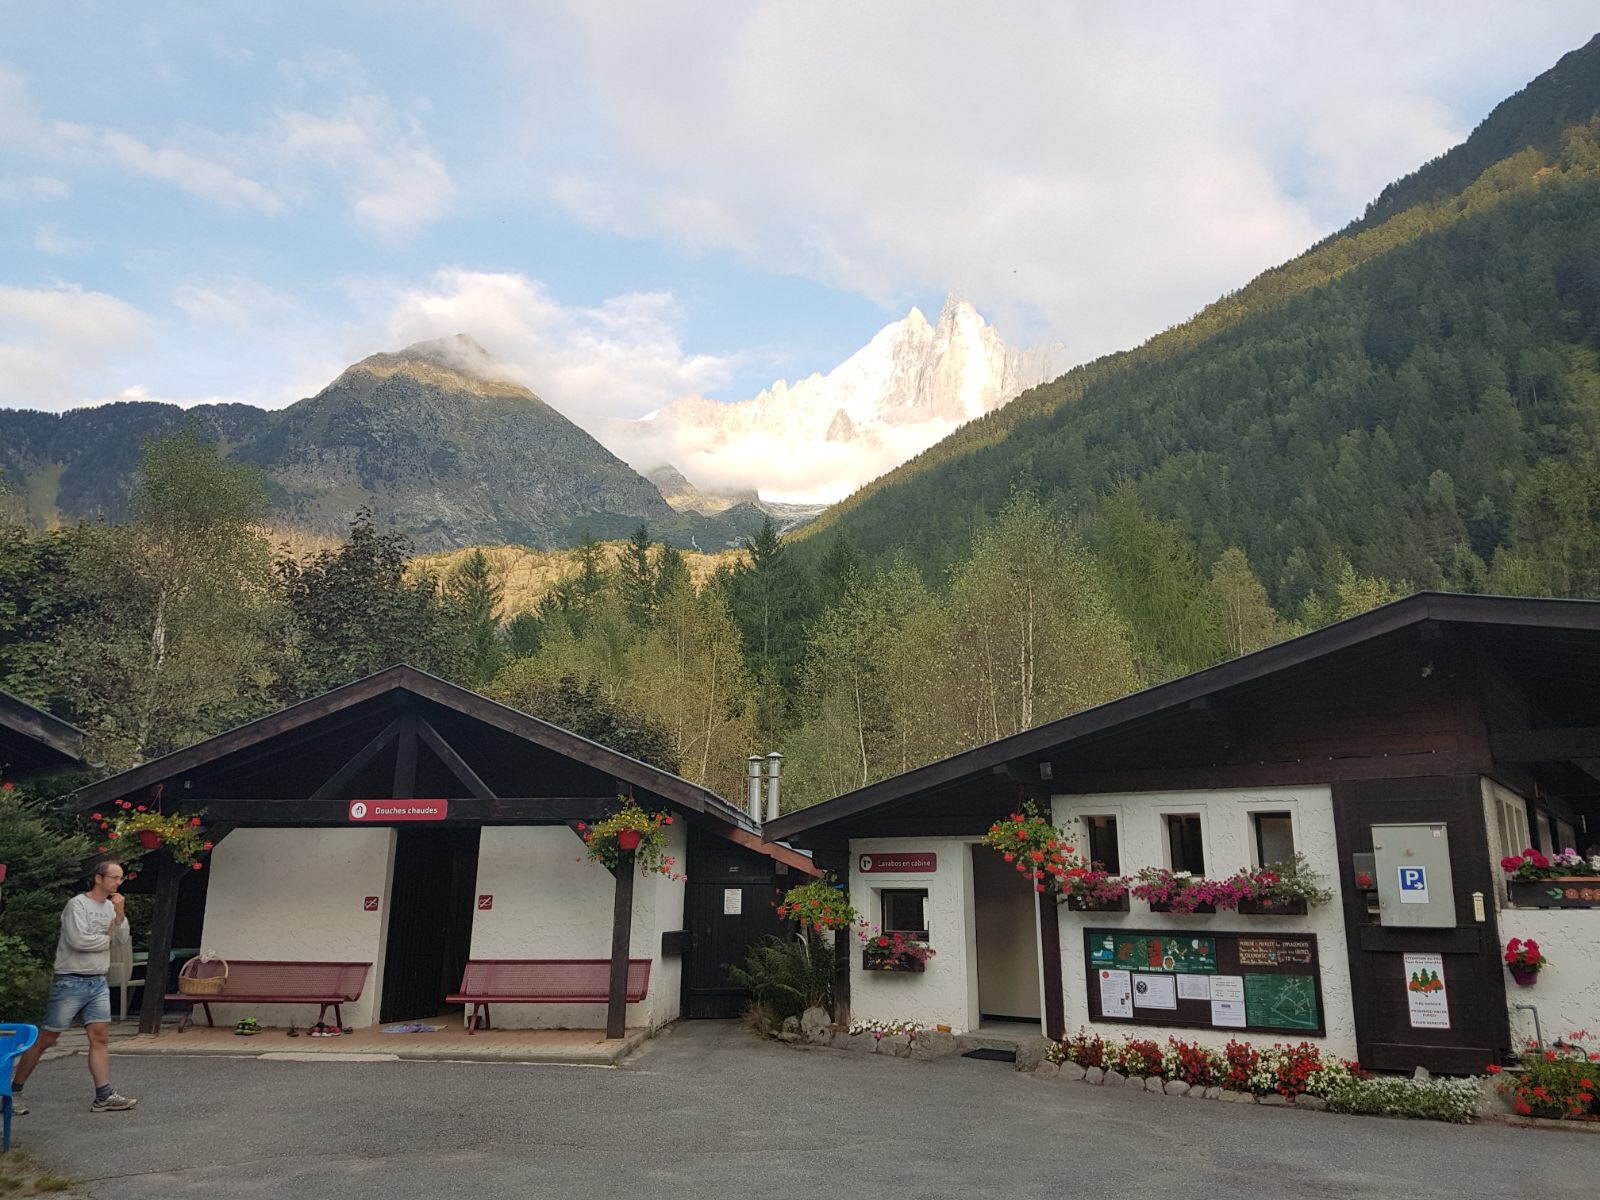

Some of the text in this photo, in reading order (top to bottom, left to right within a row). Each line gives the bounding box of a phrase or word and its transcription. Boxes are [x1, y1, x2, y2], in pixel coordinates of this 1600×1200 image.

[407, 806, 438, 814] chaudes
[878, 859, 902, 867] Lavabos
[911, 859, 931, 867] cabine
[1406, 870, 1419, 886] P
